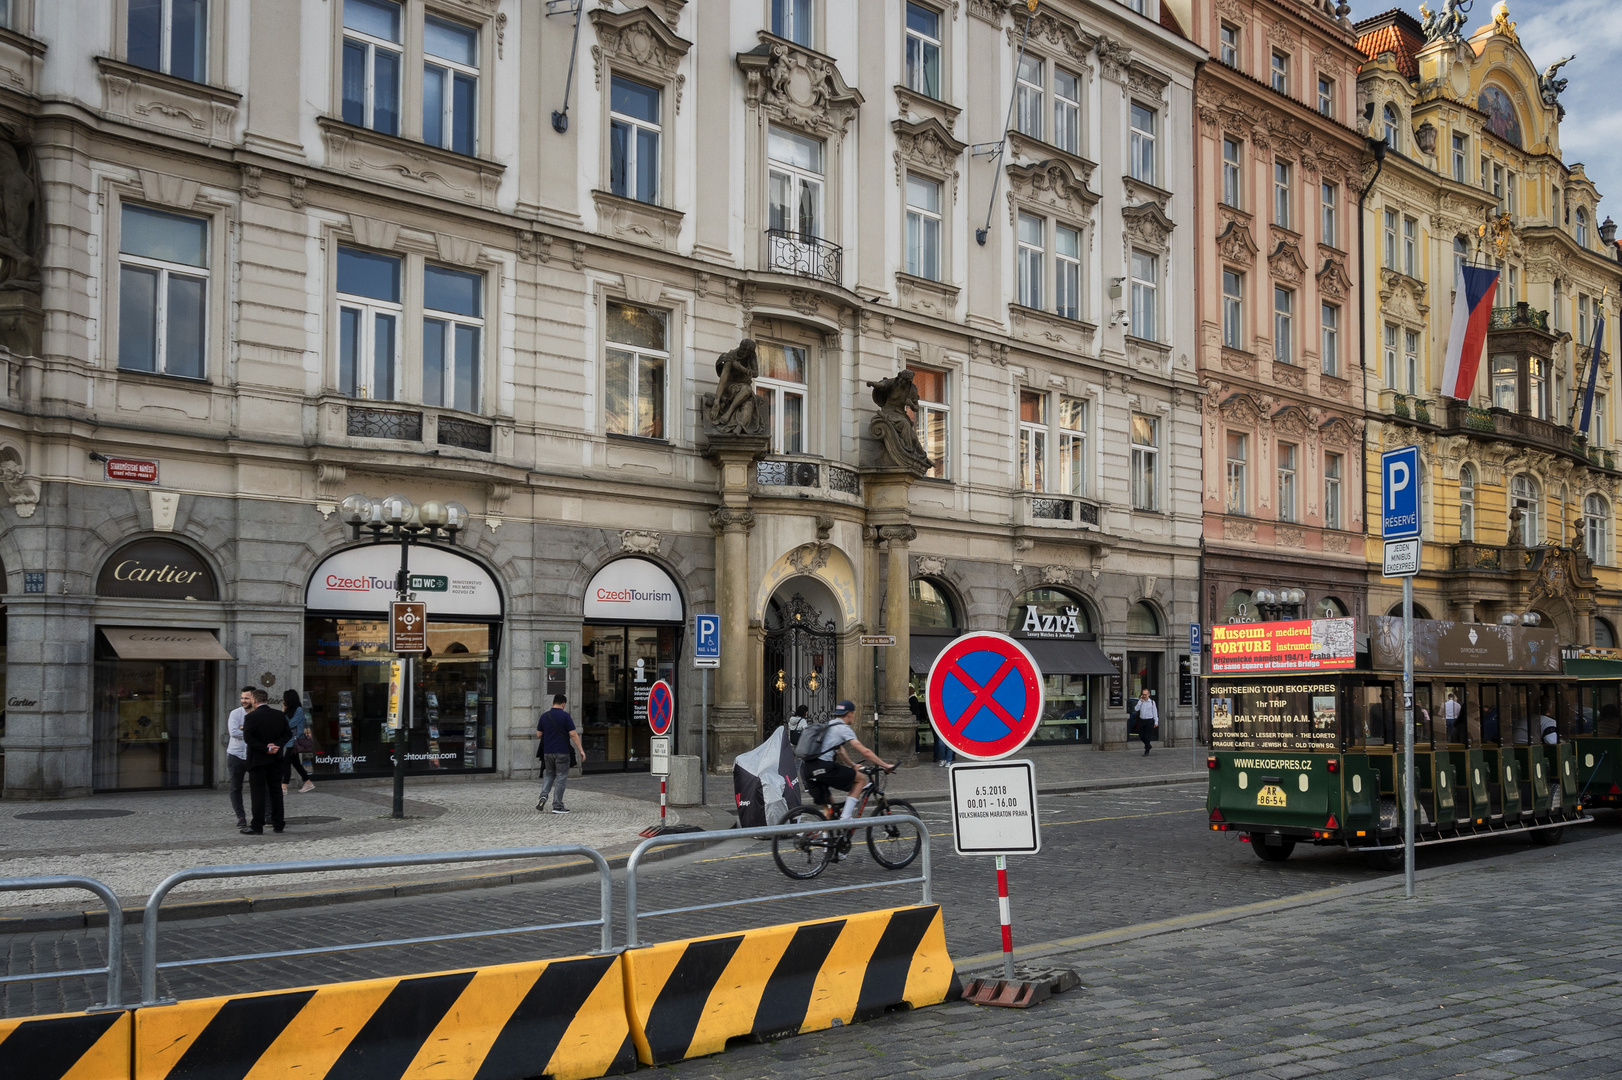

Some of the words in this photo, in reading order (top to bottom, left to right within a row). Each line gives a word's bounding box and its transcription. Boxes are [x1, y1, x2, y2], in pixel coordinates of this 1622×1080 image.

[1389, 461, 1410, 510] P
[1385, 511, 1416, 528] RÉSERVÉ
[1393, 543, 1410, 553] JEDEN
[1390, 552, 1412, 562] MINIBUS
[114, 559, 203, 584] Cartier
[1386, 561, 1415, 572] EKOEXPRES
[326, 574, 396, 590] CzechTour
[423, 578, 436, 588] WC
[597, 588, 672, 602] CzechTourism
[128, 632, 197, 642] Cartier
[700, 619, 715, 644] P
[1213, 627, 1265, 640] Museum
[1275, 626, 1311, 637] medieval
[1213, 640, 1271, 654] TORTURE
[1276, 641, 1322, 652] instruments
[1284, 653, 1304, 661] 194/1
[1309, 652, 1331, 660] Praha
[1213, 662, 1224, 670] the
[1224, 662, 1241, 670] same
[1241, 662, 1264, 671] square
[1264, 661, 1272, 669] of
[1272, 660, 1297, 669] Charles
[1297, 659, 1320, 669] Bridge
[1210, 685, 1260, 694] SIGHTSEEING
[1262, 685, 1284, 693] TOUR
[1286, 684, 1336, 693] EKOEXPRES
[7, 697, 38, 707] Cartier
[1255, 700, 1268, 708] 1hr
[1269, 700, 1287, 708] TRIP
[1234, 715, 1257, 723] DAILY
[1258, 715, 1281, 723] FROM
[1282, 715, 1292, 723] 10
[1293, 715, 1311, 723] A.M.
[315, 755, 367, 764] kudyznudy.cz
[1234, 758, 1312, 770] WWW.EKOEXPRES.CZ
[975, 785, 1007, 796] 6.5.2018
[1266, 786, 1277, 795] AR
[967, 799, 987, 809] 00.01
[997, 798, 1017, 808] 16.00
[1260, 796, 1283, 805] 86-54
